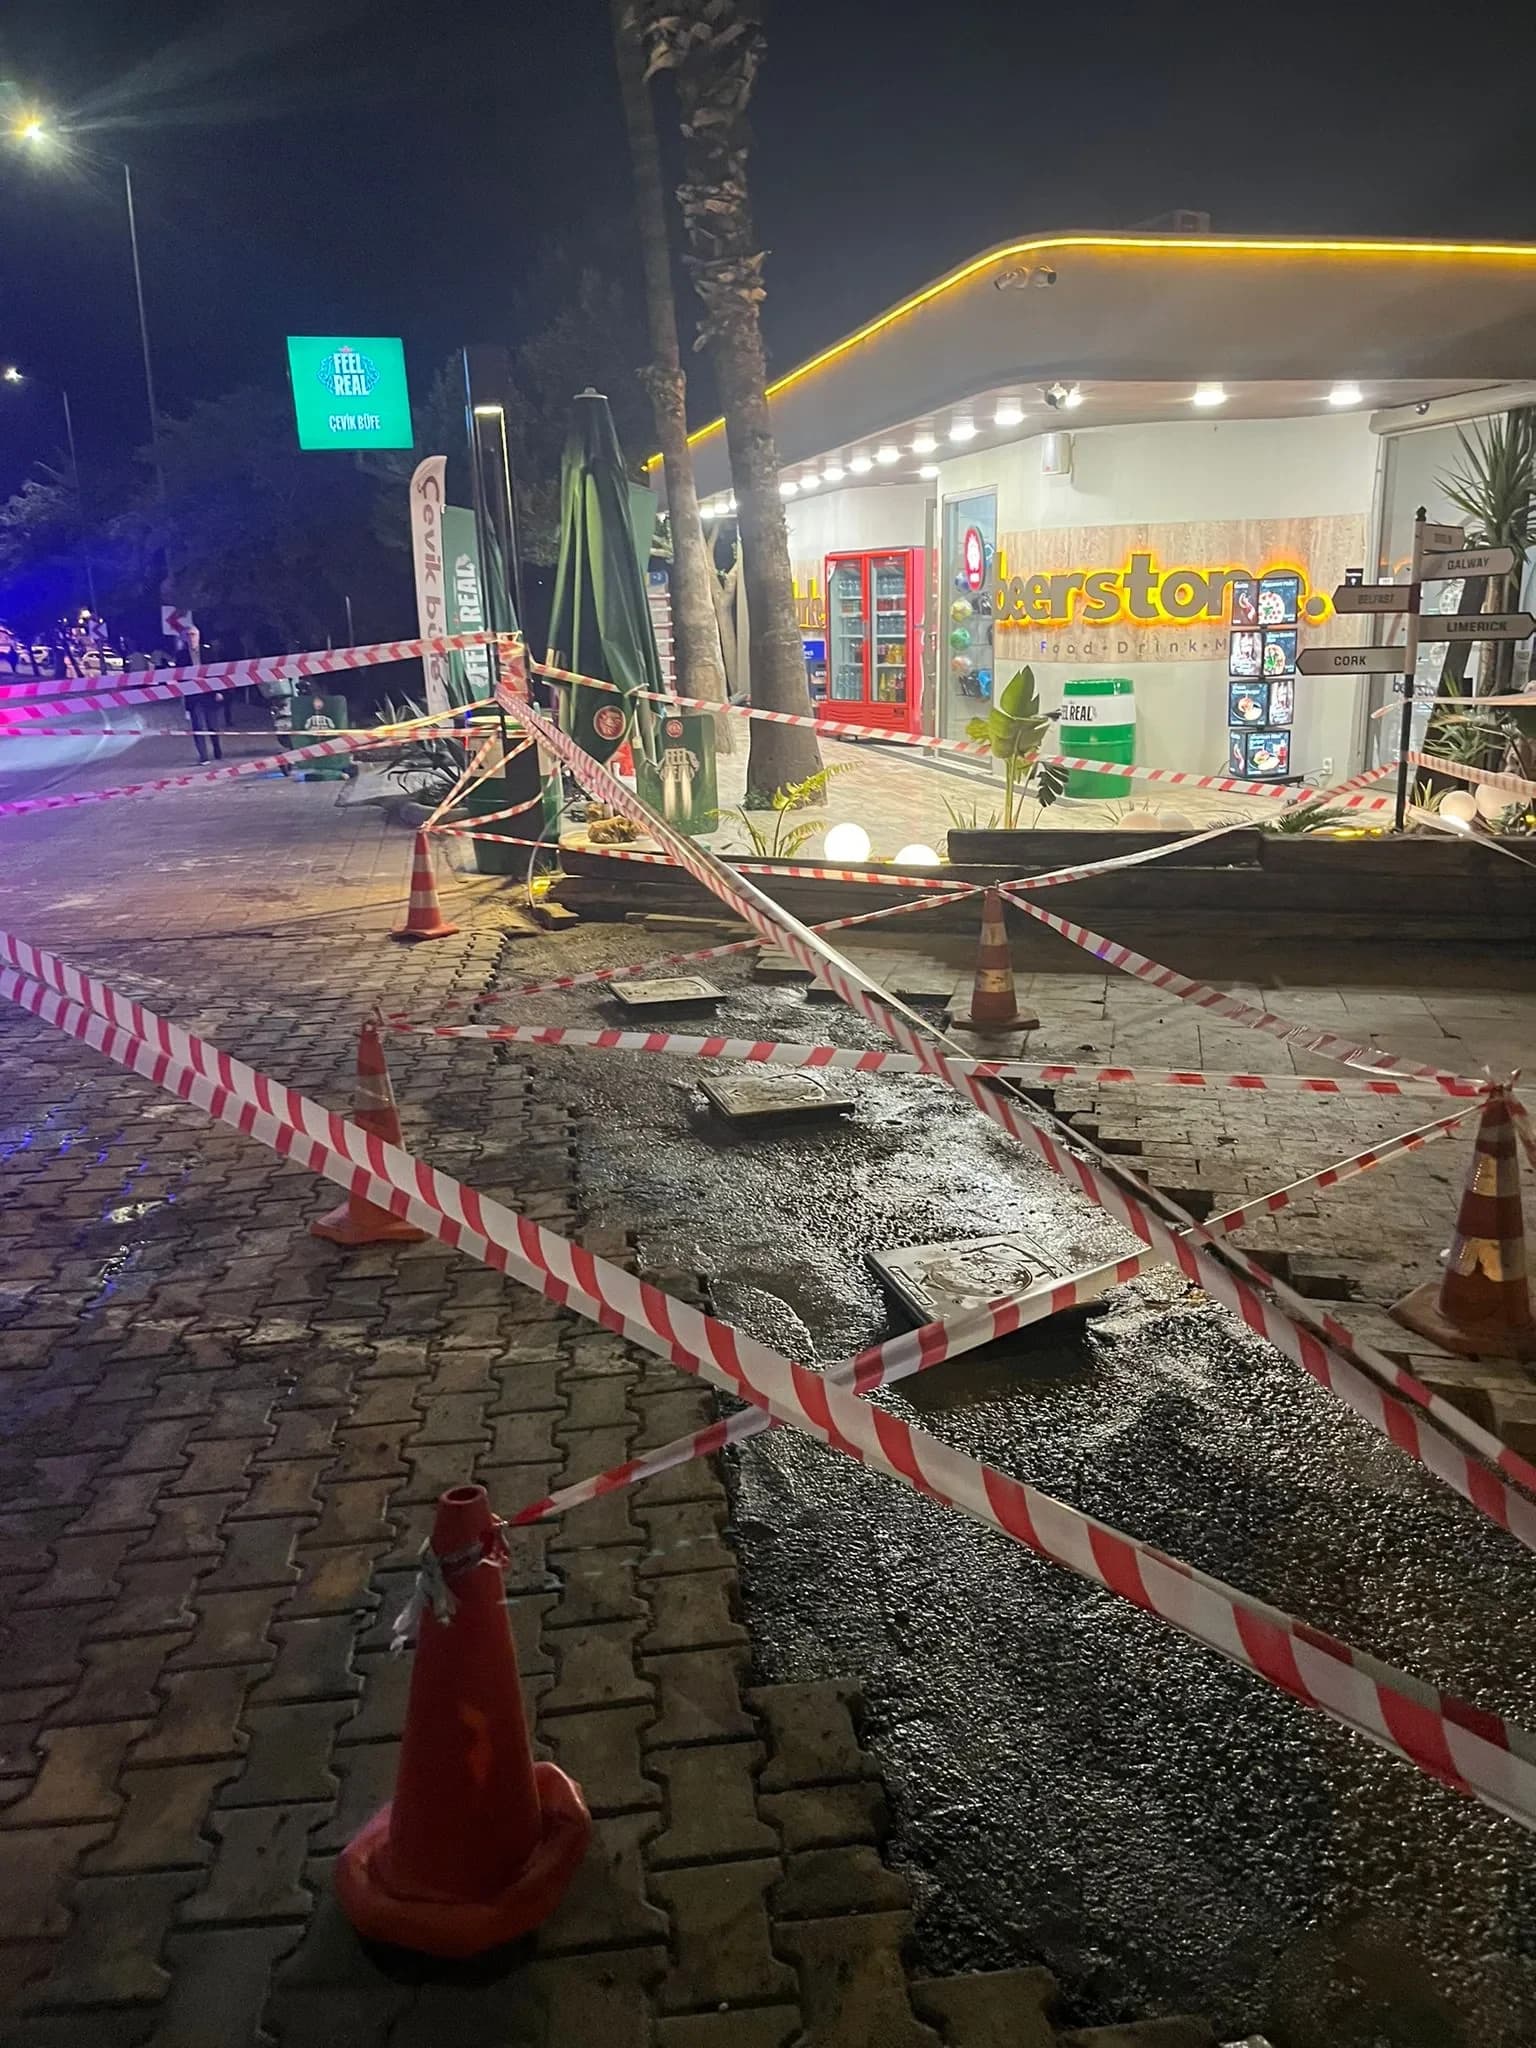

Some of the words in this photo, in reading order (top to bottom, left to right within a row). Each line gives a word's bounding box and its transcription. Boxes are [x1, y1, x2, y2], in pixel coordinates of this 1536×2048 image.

[333, 353, 364, 374] FEEL
[333, 375, 370, 395] REAL
[1447, 557, 1490, 571] GALWAY
[456, 561, 481, 623] REAL
[1446, 621, 1508, 633] LIMERICK
[1334, 656, 1367, 666] CORK
[1070, 705, 1092, 721] REAL
